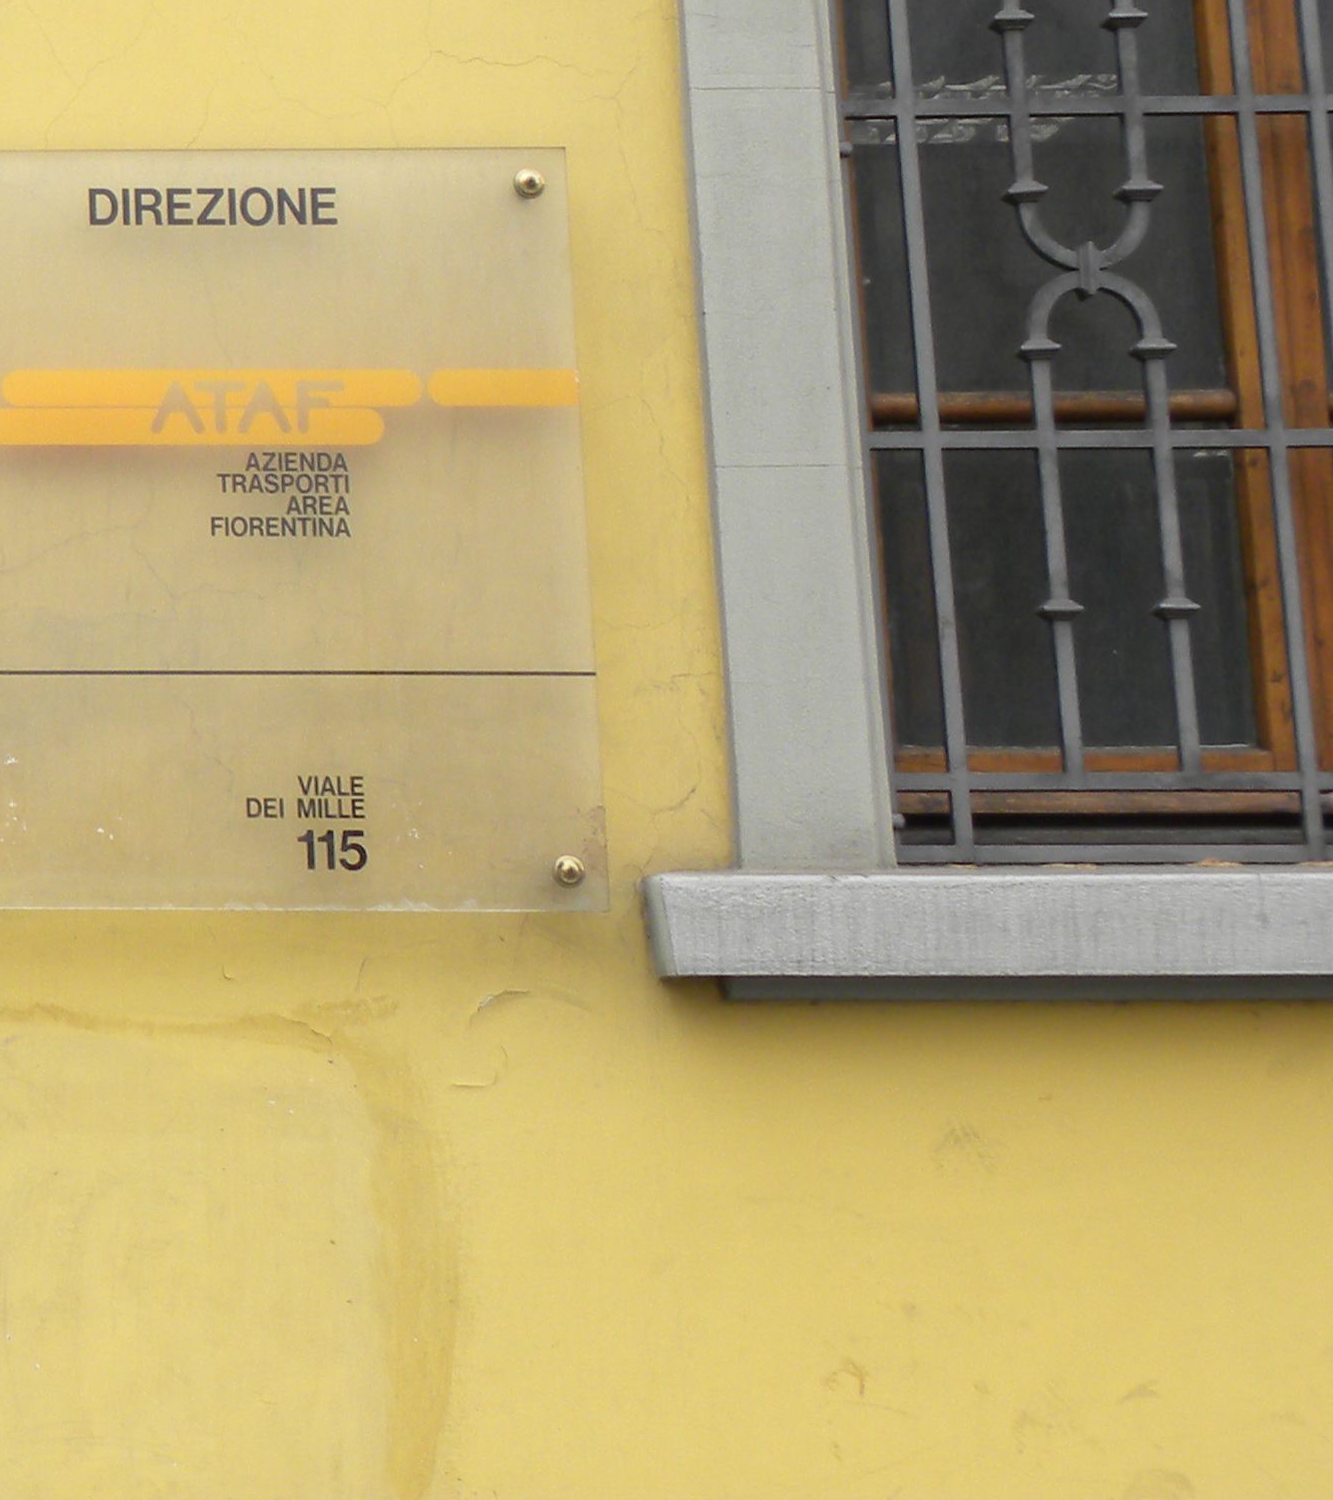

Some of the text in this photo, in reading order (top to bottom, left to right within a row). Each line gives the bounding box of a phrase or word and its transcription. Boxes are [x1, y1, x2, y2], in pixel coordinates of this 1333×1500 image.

[89, 187, 337, 226] DIREZIONE
[150, 380, 344, 433] ATAF
[246, 452, 347, 471] AZIENDA
[217, 474, 349, 493] TRASPORTI
[287, 496, 349, 515] AREA
[211, 517, 350, 537] FIORENTINA
[298, 776, 364, 796] VIALE
[247, 798, 365, 818] DEI MILLE
[298, 830, 367, 870] 115
